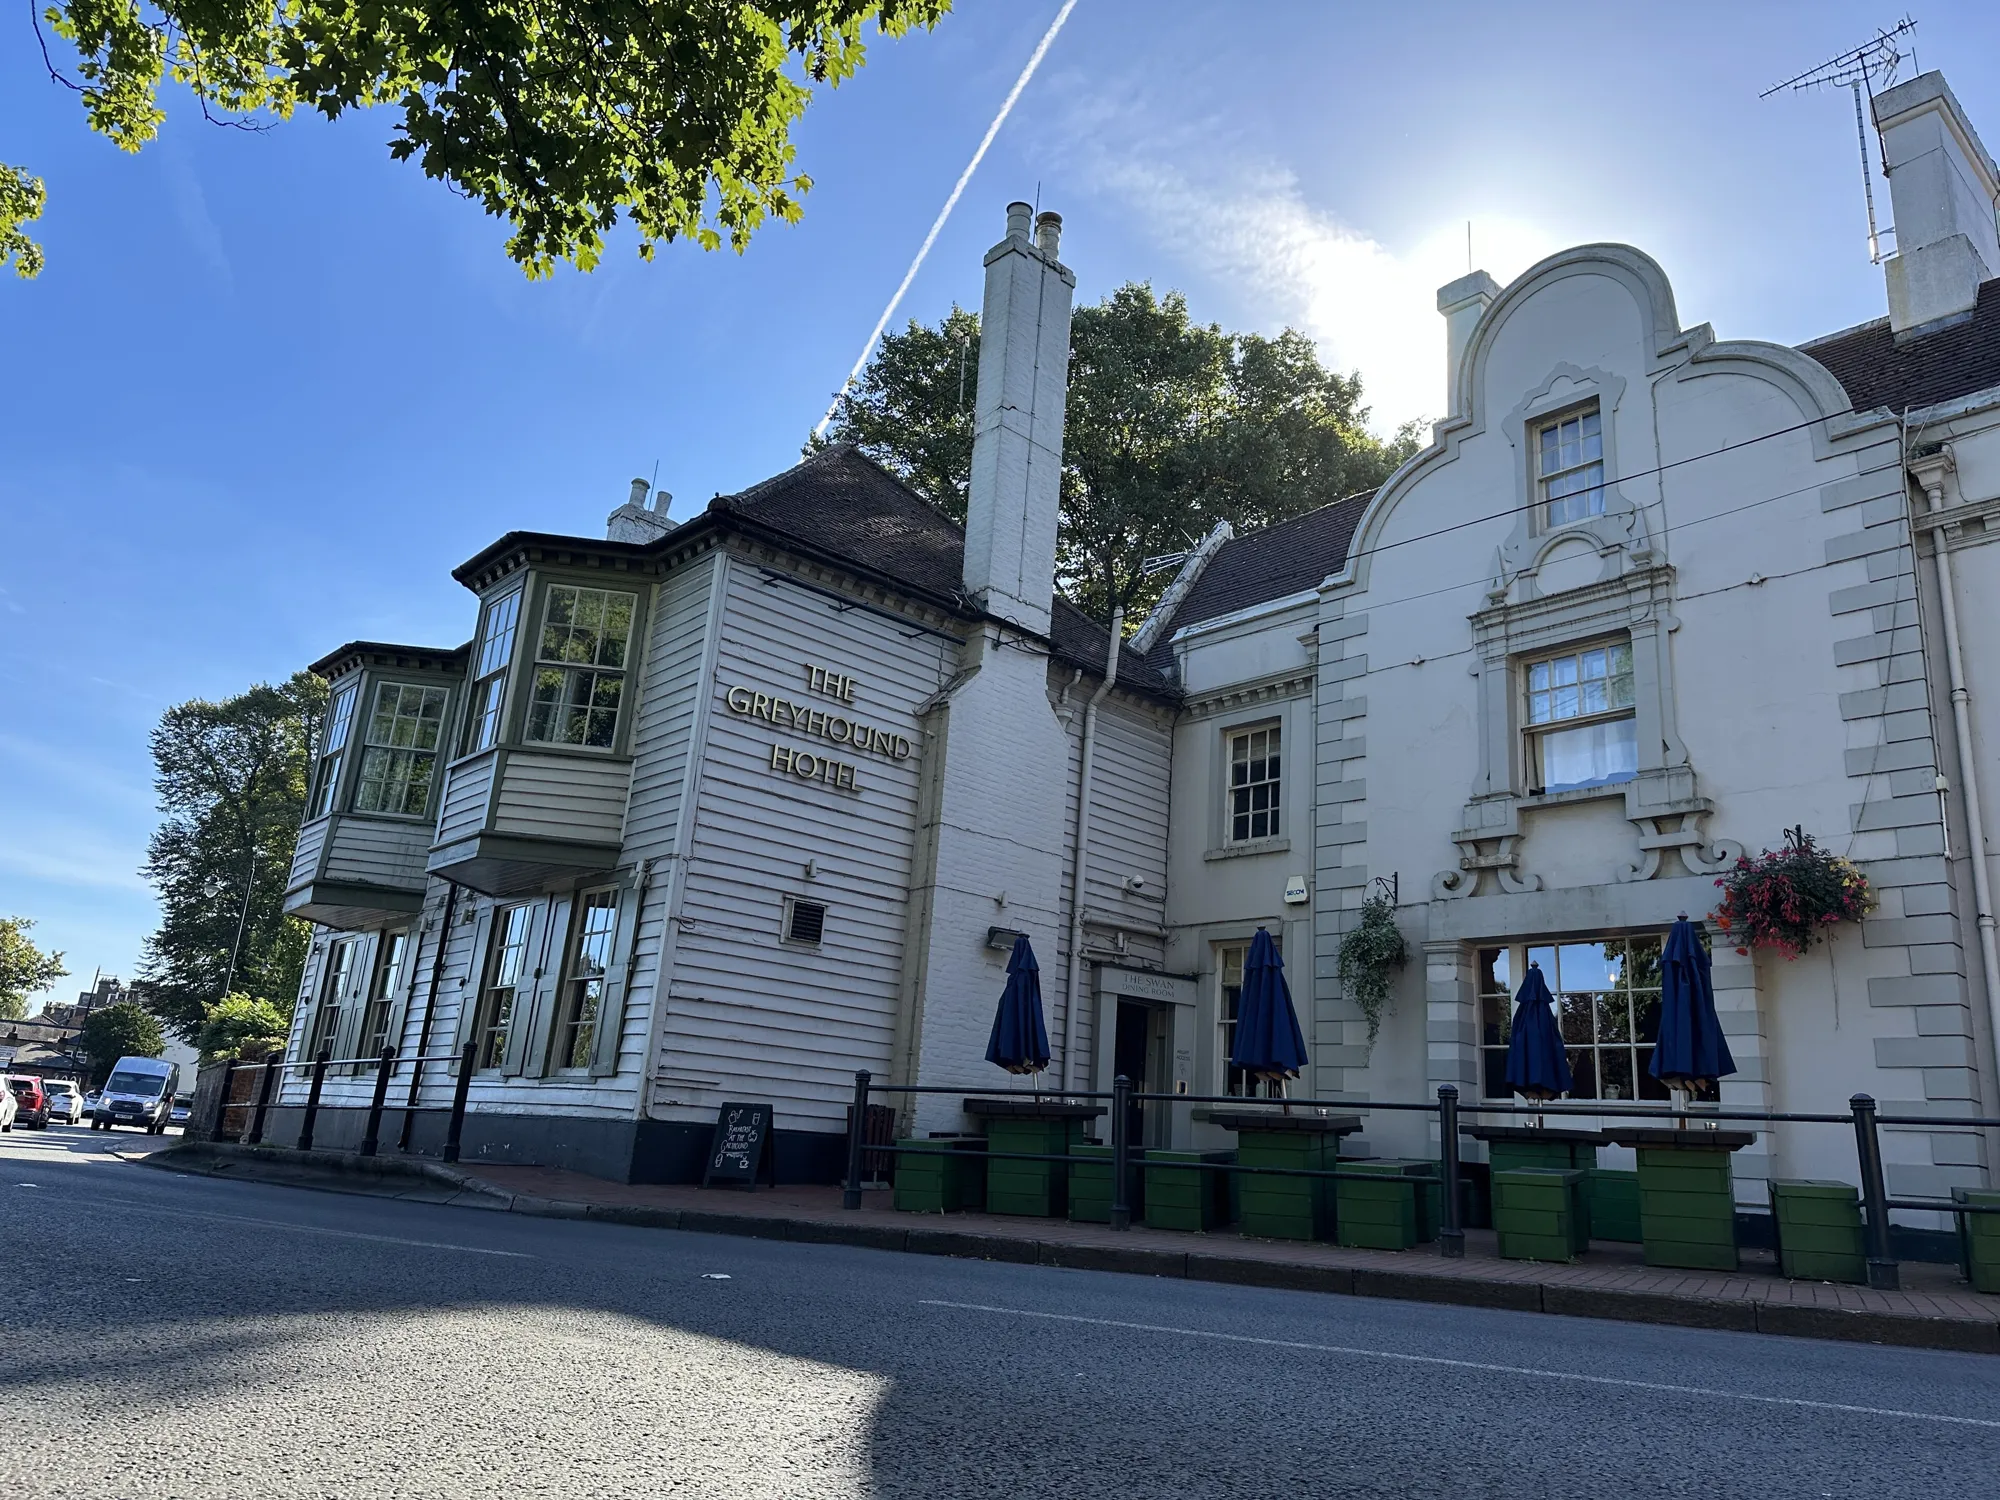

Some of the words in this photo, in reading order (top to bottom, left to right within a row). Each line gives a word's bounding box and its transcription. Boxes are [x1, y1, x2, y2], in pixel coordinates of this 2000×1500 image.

[806, 663, 857, 701] THE
[727, 686, 913, 760] GREYHOUND
[772, 744, 864, 792] HOTEL
[1122, 983, 1149, 994] DINING
[1151, 987, 1175, 998] ROOM
[1123, 973, 1143, 985] THE
[1146, 977, 1175, 990] SWAN
